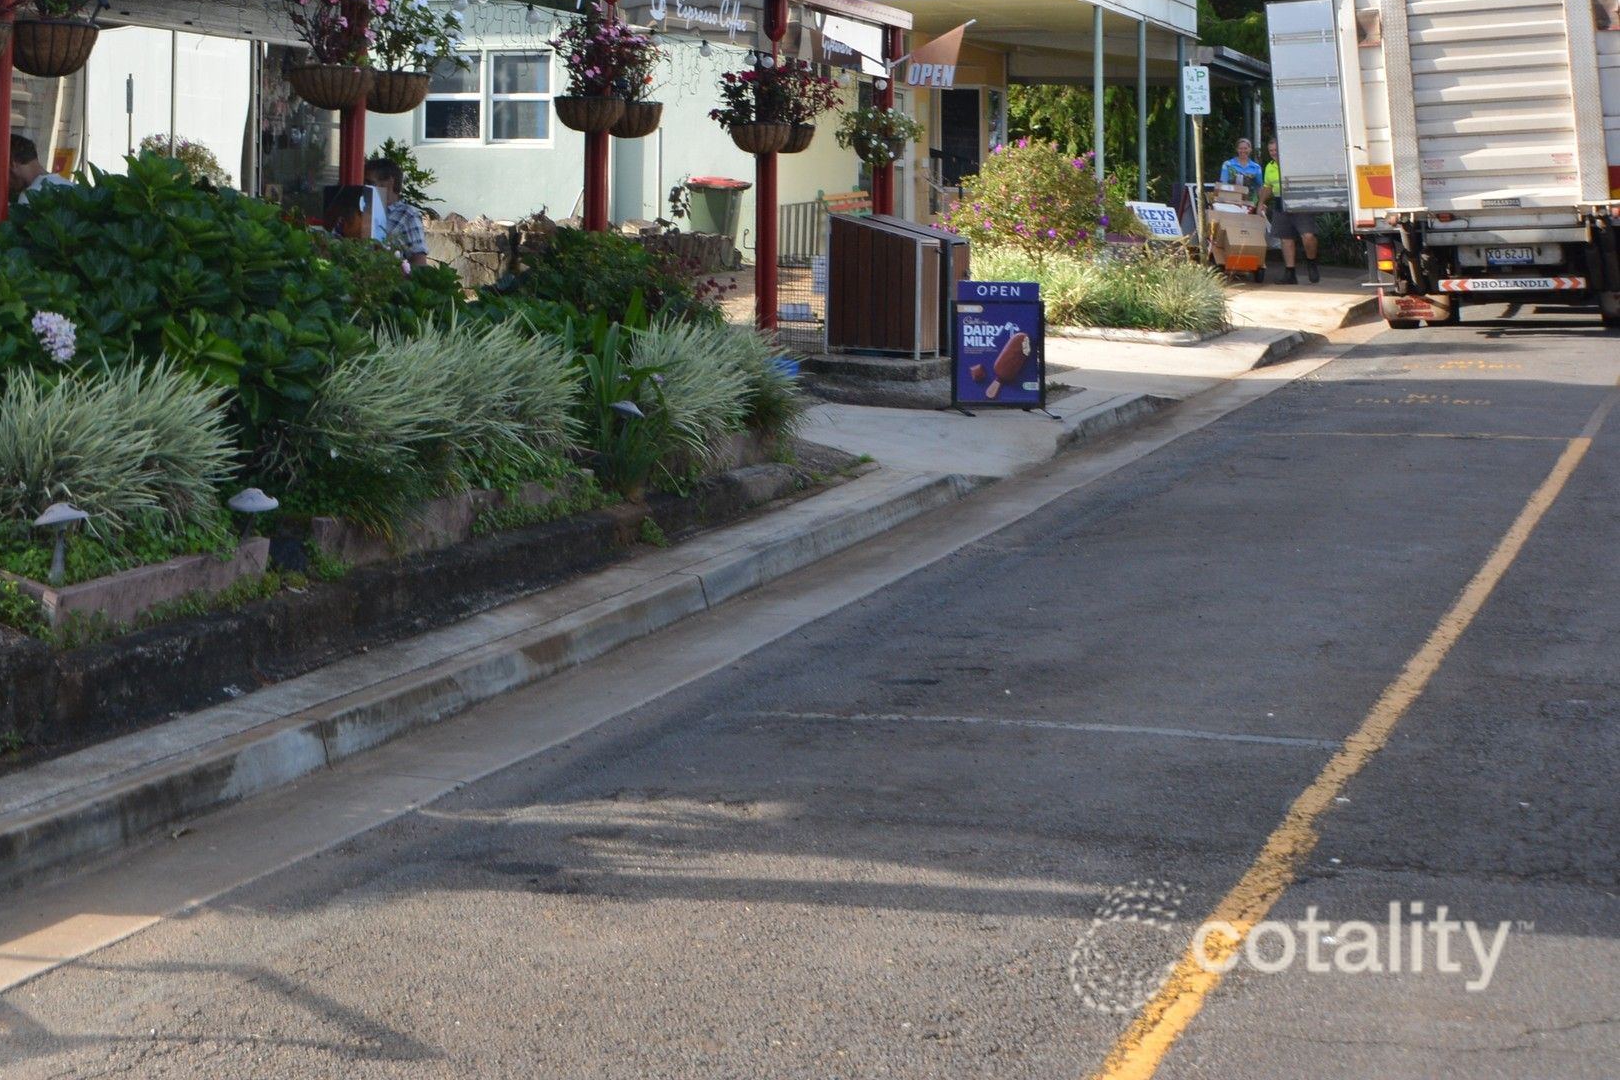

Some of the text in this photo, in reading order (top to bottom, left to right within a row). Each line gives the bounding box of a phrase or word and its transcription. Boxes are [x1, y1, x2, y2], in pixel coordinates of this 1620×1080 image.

[907, 63, 956, 88] OPEN
[1138, 209, 1175, 221] KEYS
[1472, 279, 1550, 289] DHOLLANDIA
[976, 285, 1021, 297] OPEN
[963, 324, 1004, 337] DAIRY
[963, 336, 997, 348] MILK
